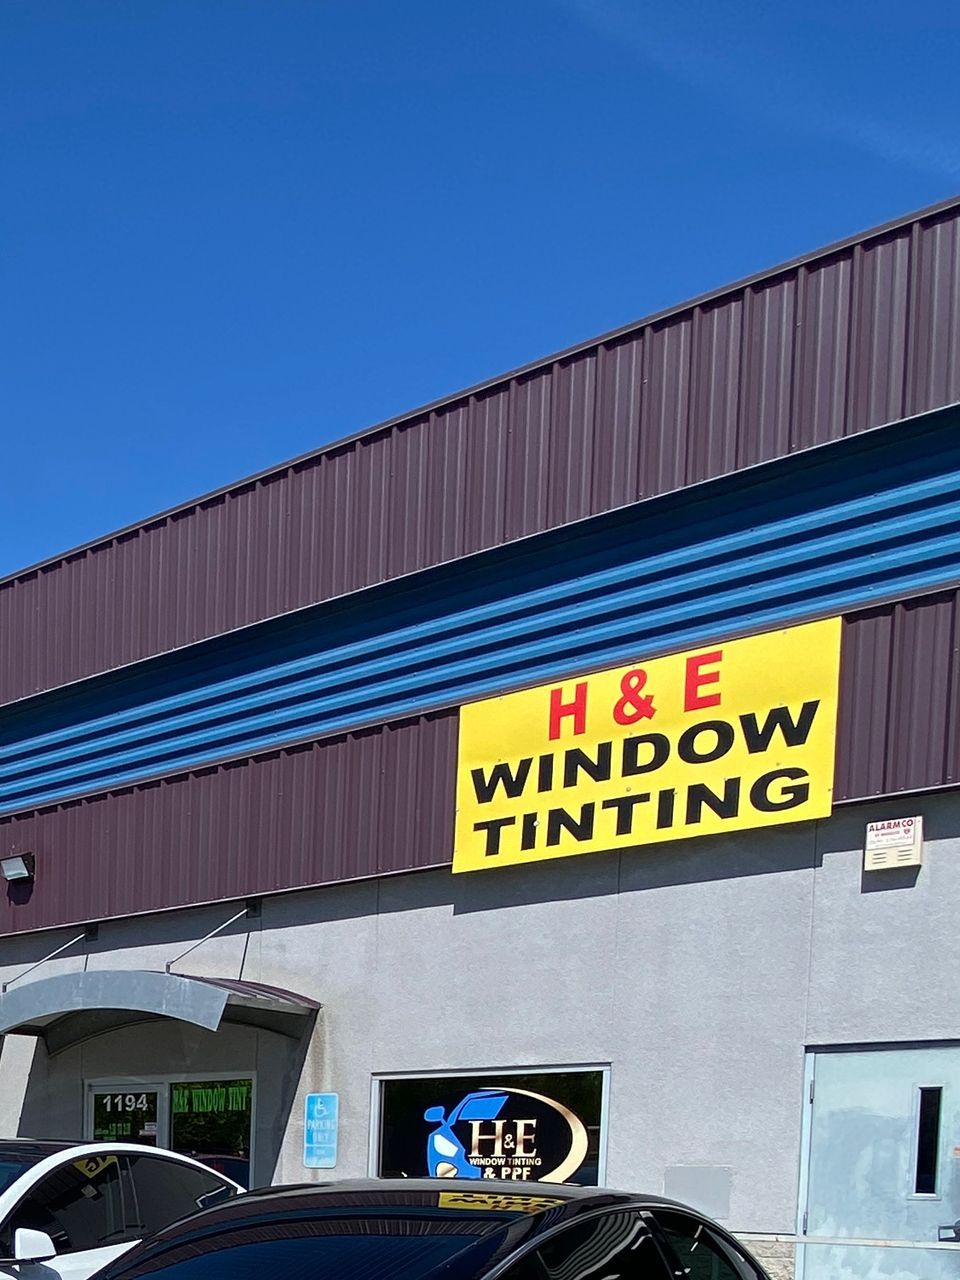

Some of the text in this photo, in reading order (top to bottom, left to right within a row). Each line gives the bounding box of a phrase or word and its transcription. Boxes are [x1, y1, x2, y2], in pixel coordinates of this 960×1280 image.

[548, 650, 724, 740] H & E
[471, 700, 820, 804] WINDOW
[472, 767, 810, 857] TINTING
[869, 819, 914, 832] ALARMCO
[103, 1094, 149, 1112] 1194
[467, 1119, 537, 1157] H&E
[469, 1157, 542, 1166] WINDOW TINTING
[501, 1167, 531, 1181] PPF
